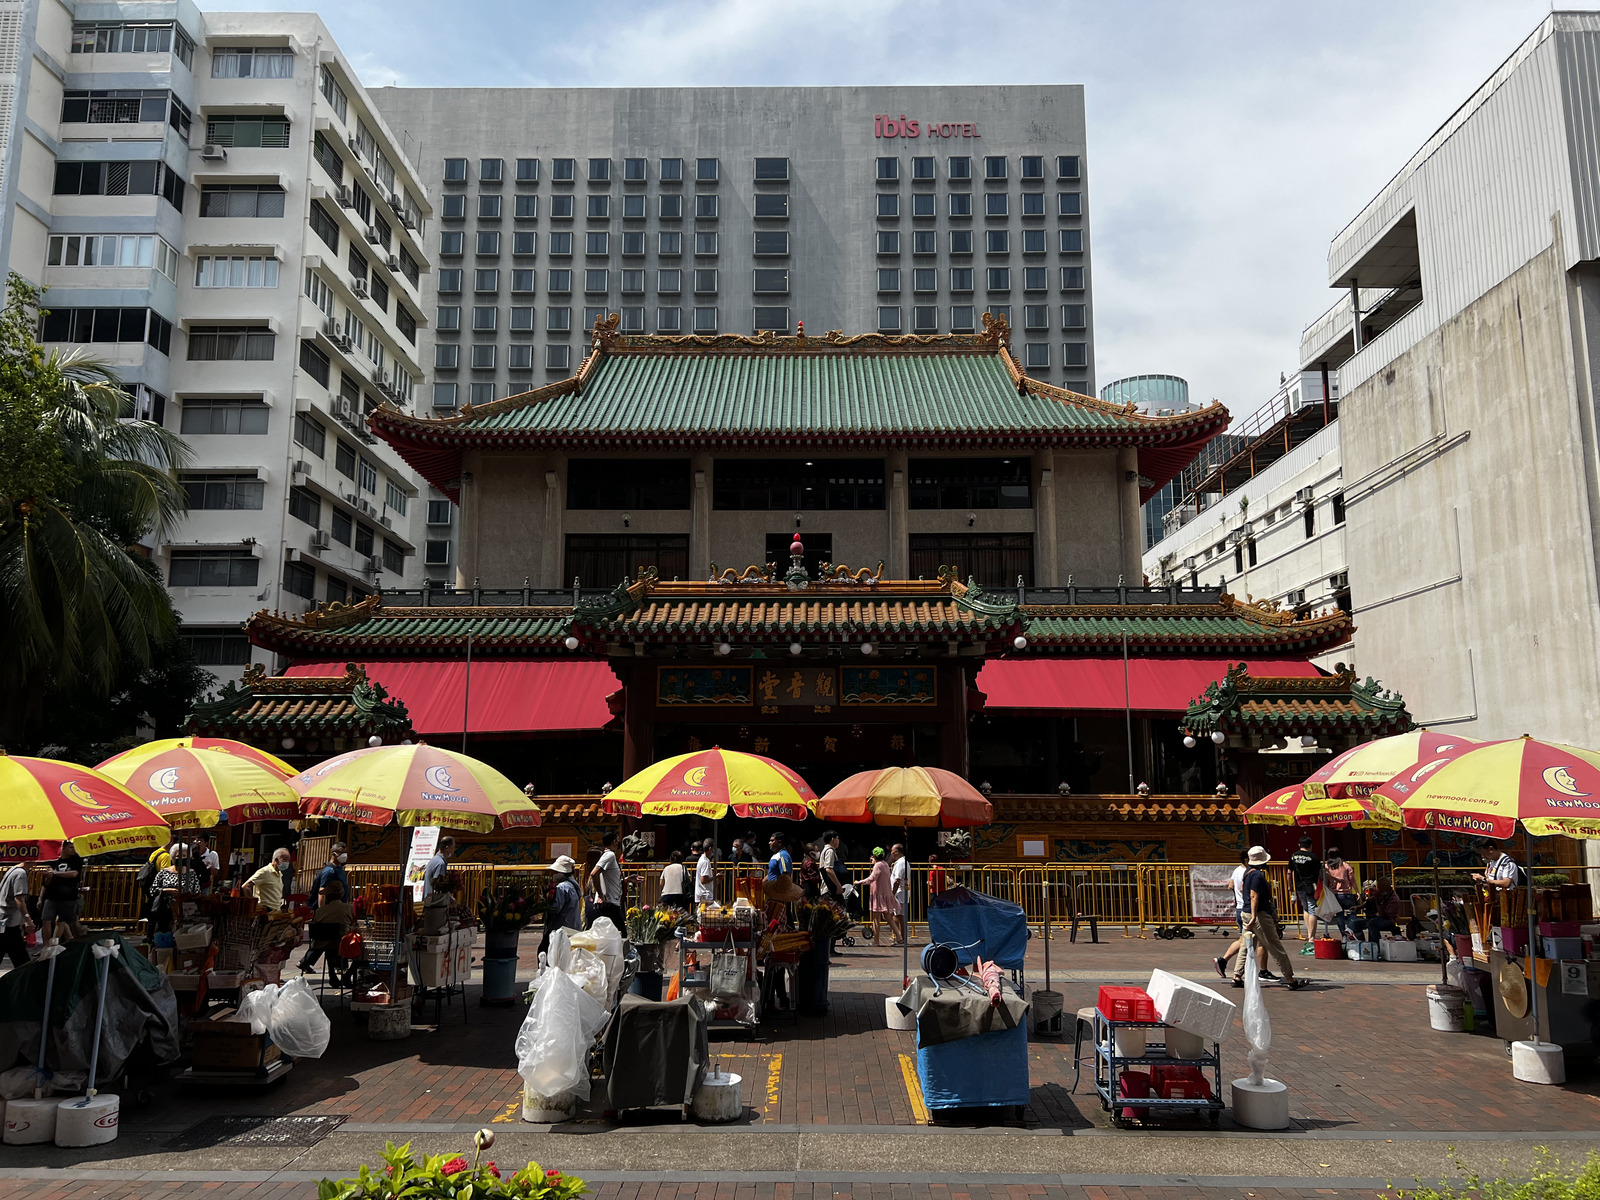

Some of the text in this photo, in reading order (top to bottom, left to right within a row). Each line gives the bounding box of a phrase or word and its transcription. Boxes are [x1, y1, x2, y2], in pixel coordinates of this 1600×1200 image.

[875, 114, 981, 138] ibis HOTEL
[1426, 794, 1500, 806] newmoon.com.sg
[443, 816, 480, 826] Singapore
[107, 838, 116, 846] in
[116, 834, 156, 845] Singapore
